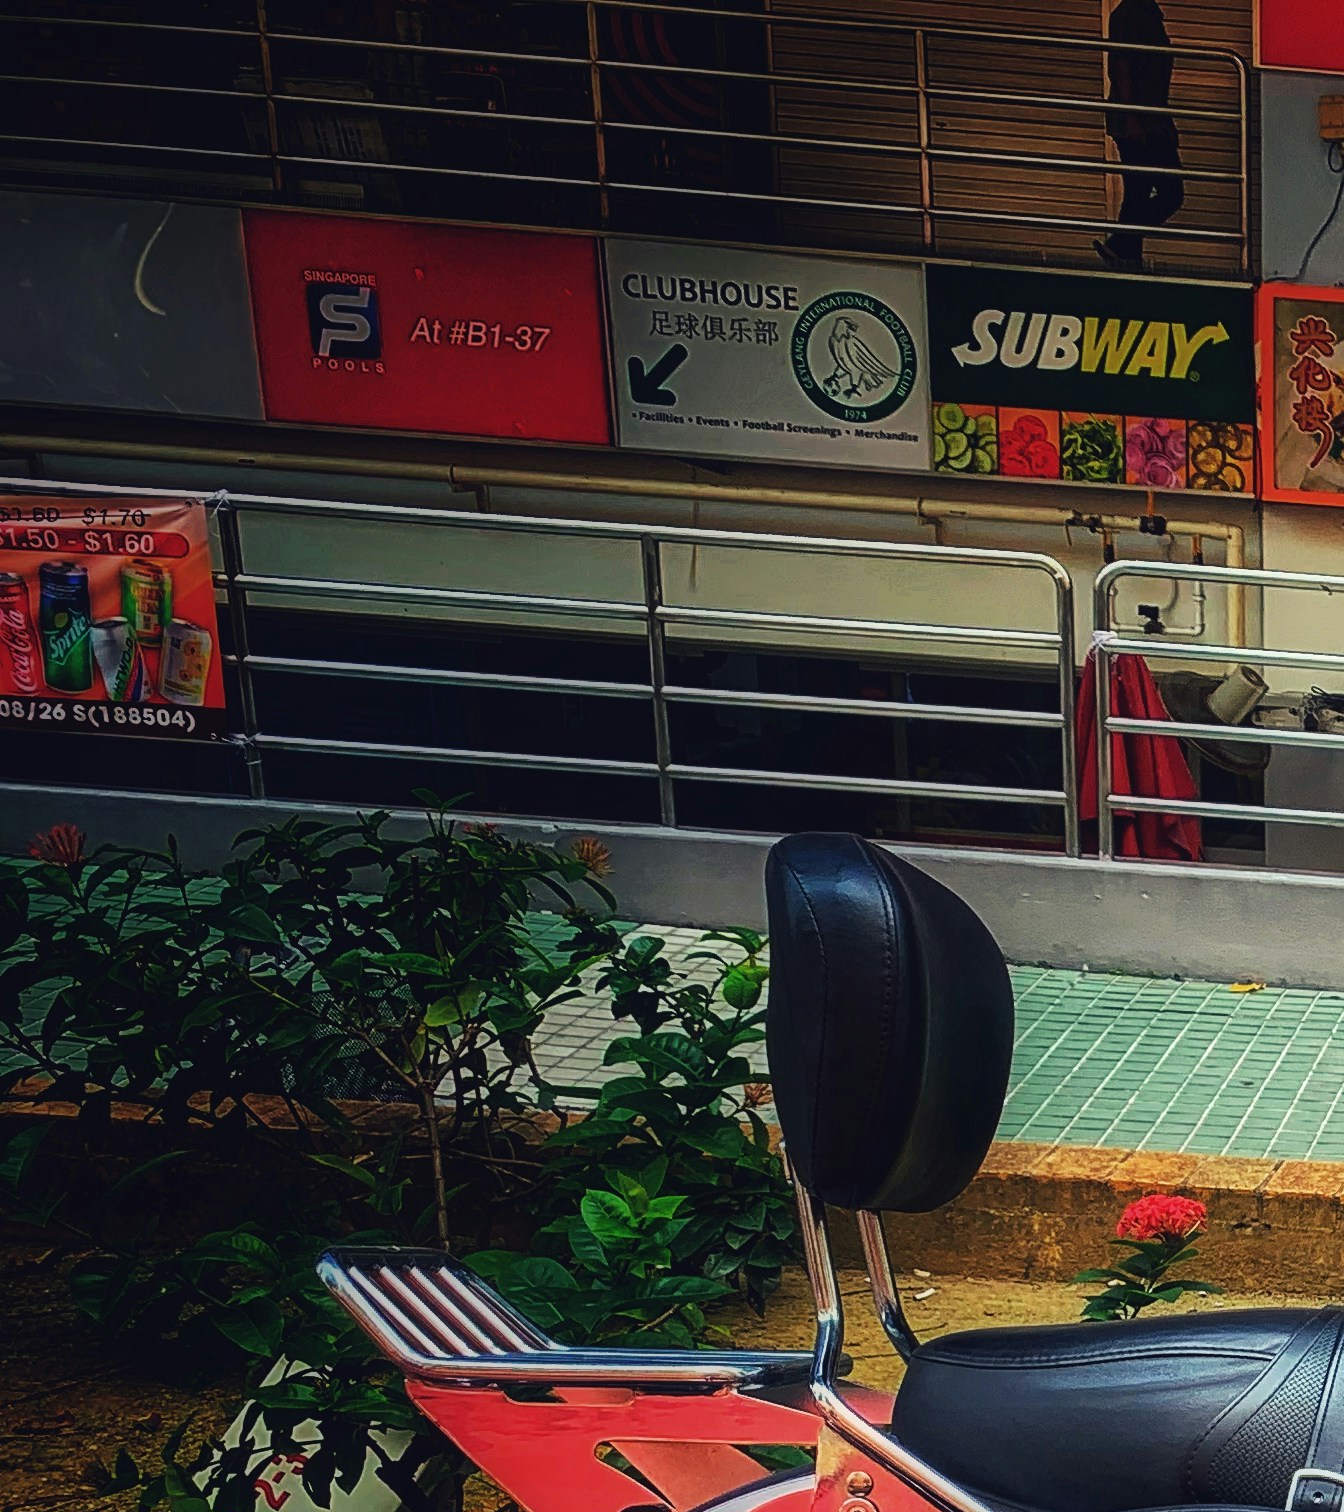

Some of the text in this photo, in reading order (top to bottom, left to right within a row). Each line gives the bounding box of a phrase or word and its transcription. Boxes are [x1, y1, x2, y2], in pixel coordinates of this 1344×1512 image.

[303, 269, 377, 287] SINGAPORE
[622, 273, 800, 311] CLUBHOUSE
[409, 316, 552, 352] At #B1-37
[649, 310, 779, 346] 足球俱乐部
[950, 308, 1231, 380] SUBWAY
[312, 357, 386, 374] POOLS
[639, 411, 919, 442] Facilities Events Football Screenings Merchandise
[84, 530, 154, 554] $1.60
[50, 612, 90, 660] Sprite
[73, 706, 196, 732] S(188504)
